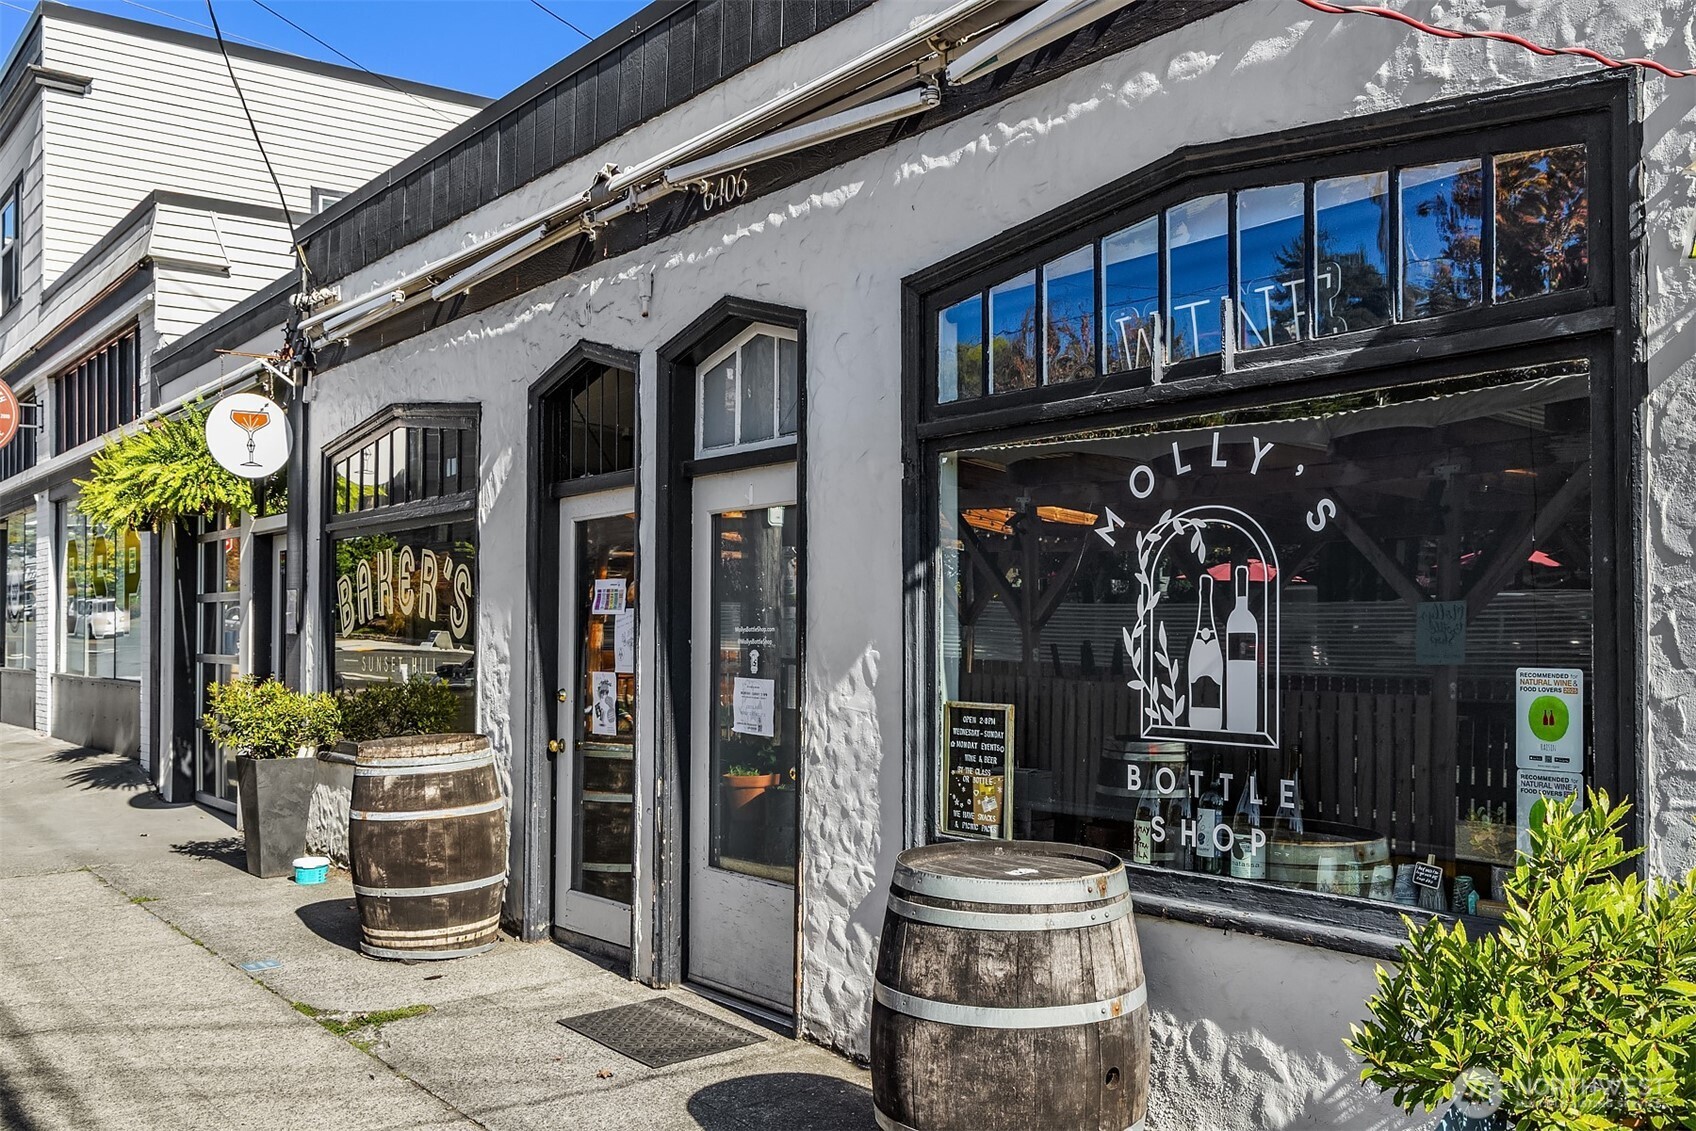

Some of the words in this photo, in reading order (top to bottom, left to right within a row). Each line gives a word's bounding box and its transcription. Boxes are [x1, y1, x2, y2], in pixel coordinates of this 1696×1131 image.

[703, 168, 748, 211] 6406
[1094, 432, 1336, 547] MOLLY'S
[337, 545, 472, 639] BAKER'S
[361, 656, 403, 673] SUNSET
[412, 657, 437, 674] HILL
[963, 715, 977, 724] OPEN
[956, 741, 978, 749] MONDAY
[981, 742, 1000, 752] EVENTS
[984, 755, 998, 765] BEER
[975, 768, 991, 776] GLASS
[1520, 774, 1570, 783] RECOMMENDED
[1127, 764, 1295, 809] BOTTLE
[1520, 780, 1553, 789] NATURAL
[1539, 789, 1563, 797] LOVERS
[953, 809, 961, 818] WE
[962, 811, 975, 820] HAVE
[977, 813, 997, 823] SNACKS
[961, 822, 979, 831] PICNIC
[1151, 815, 1267, 857] SHOP
